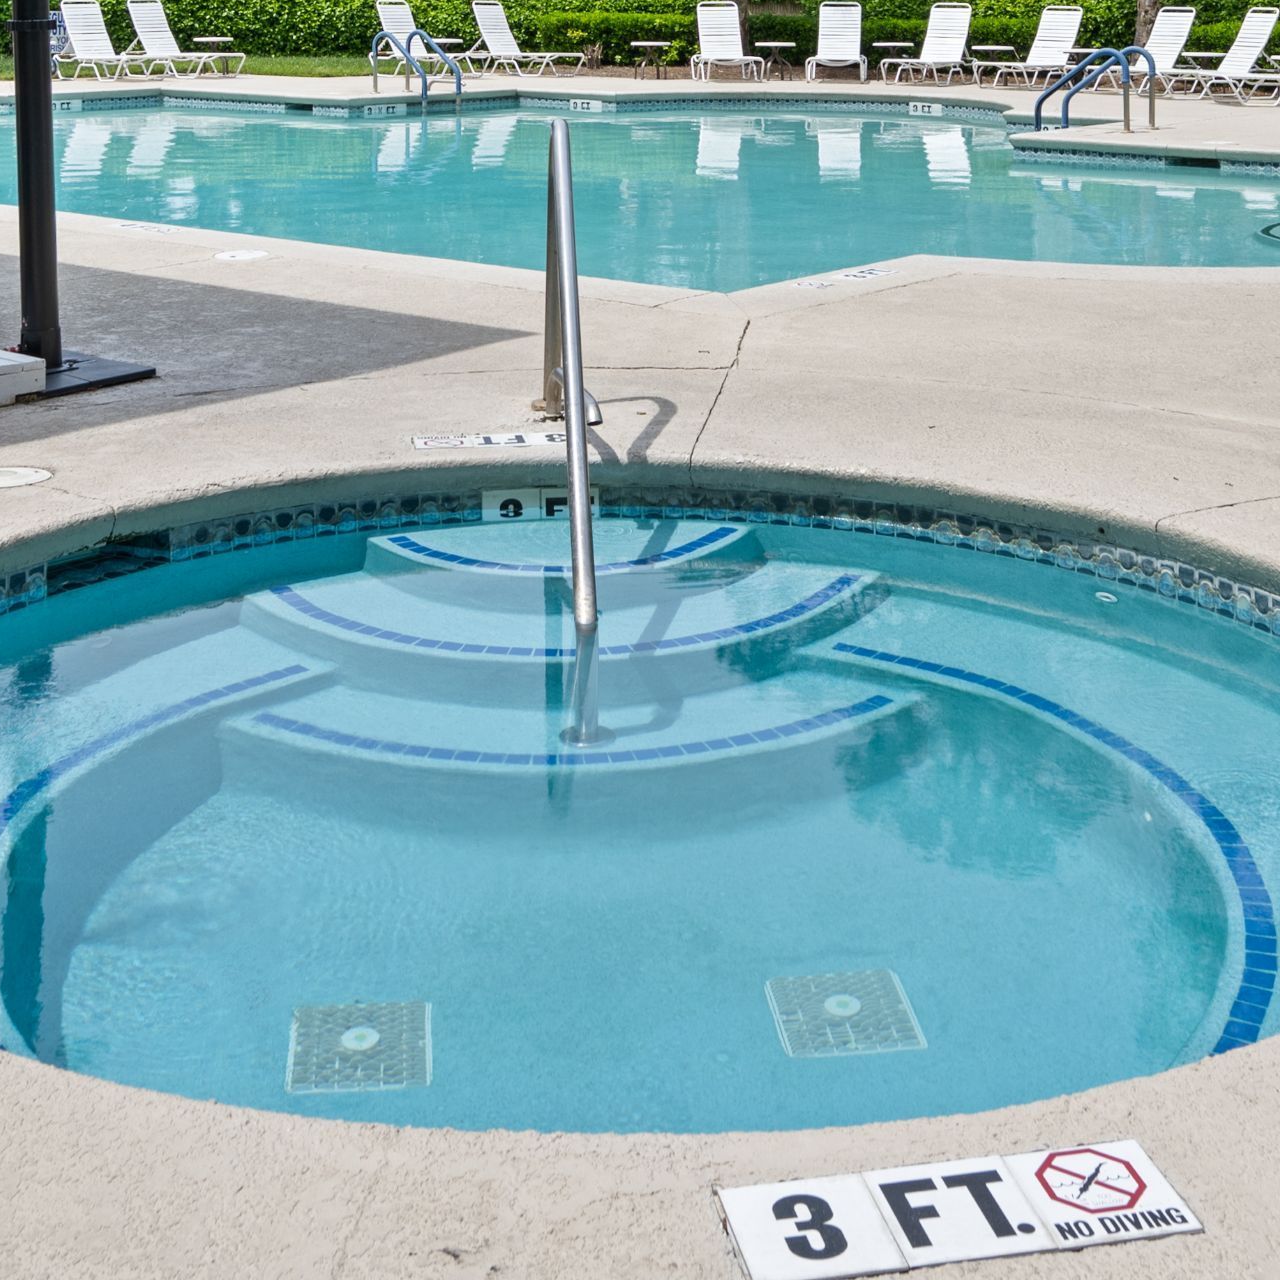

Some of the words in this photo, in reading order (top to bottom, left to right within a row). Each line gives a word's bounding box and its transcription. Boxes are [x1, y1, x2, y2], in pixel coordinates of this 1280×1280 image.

[772, 1193, 849, 1260] 3
[878, 1168, 1037, 1249] FT.
[1054, 1220, 1095, 1241] NO
[1098, 1207, 1189, 1235] DIVING
